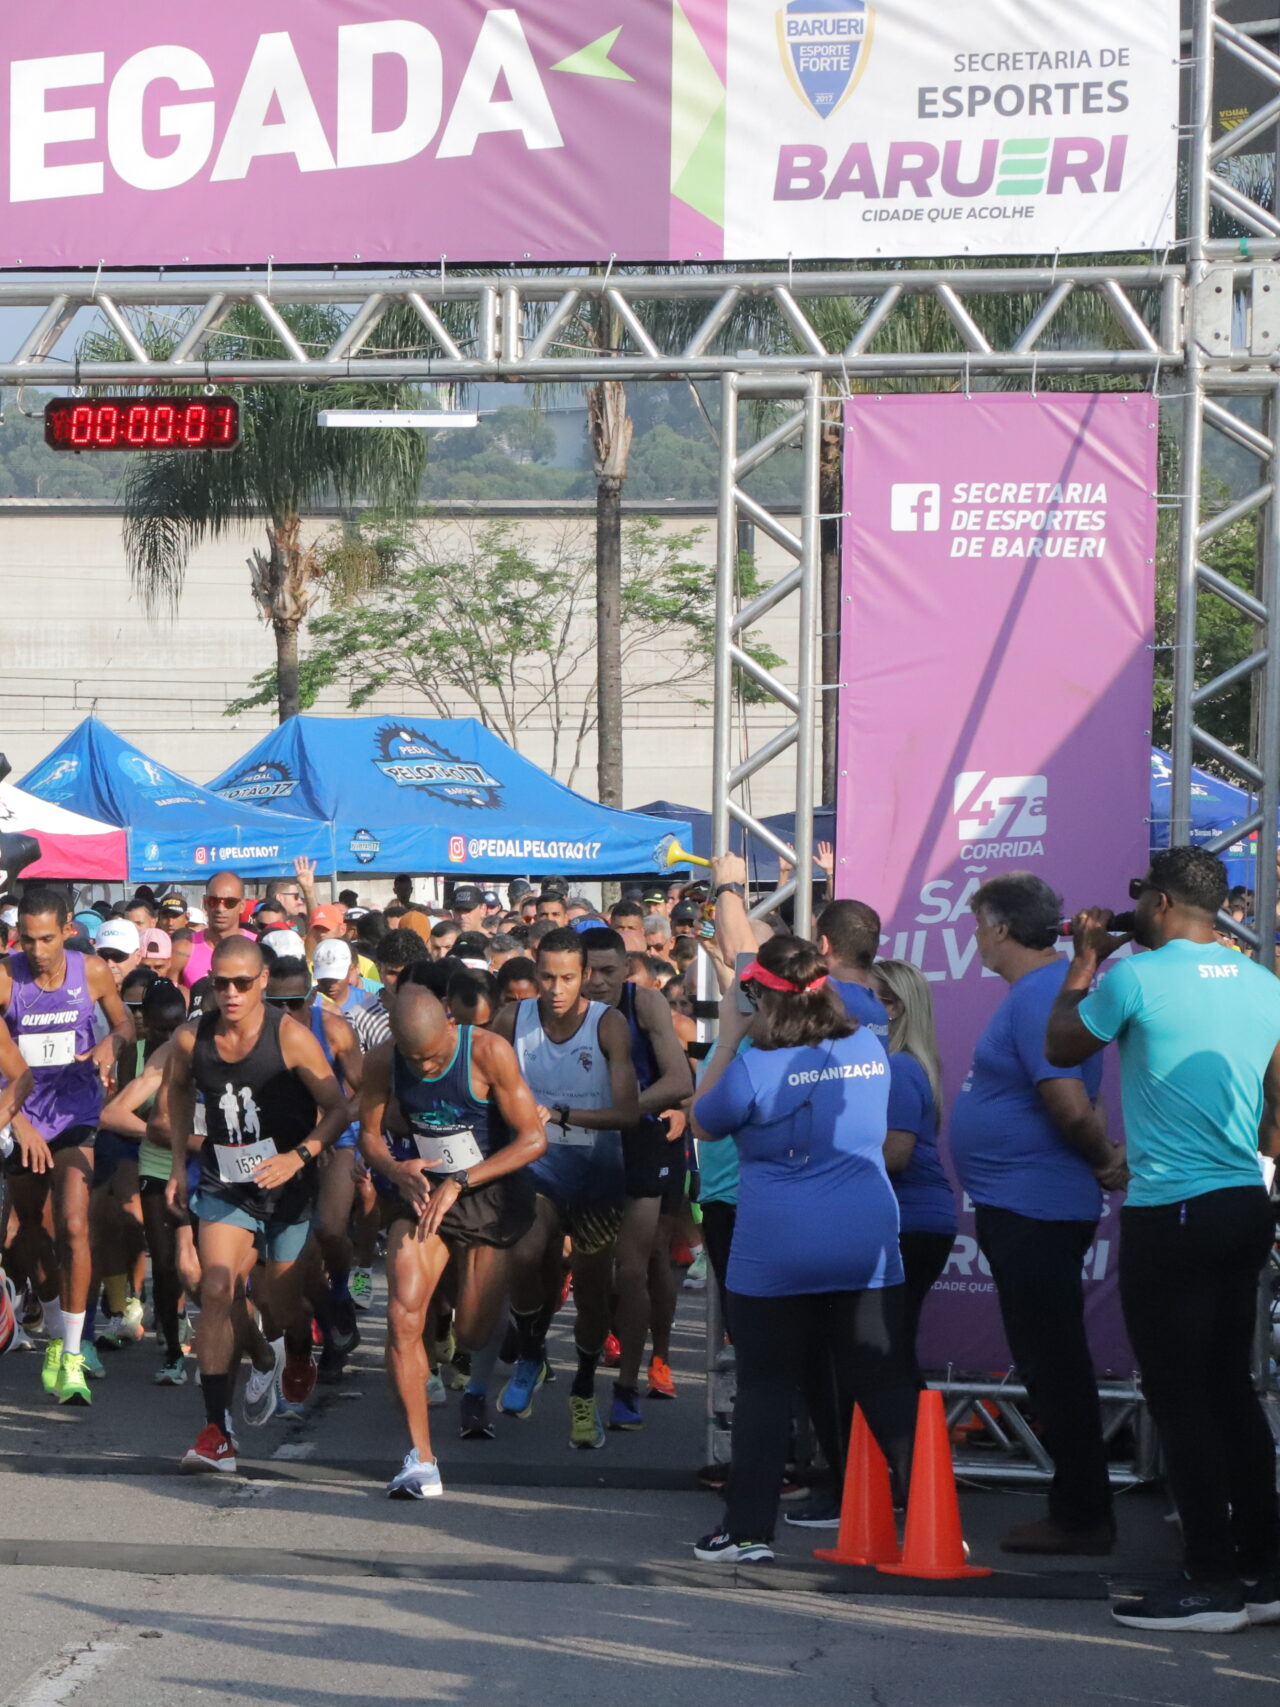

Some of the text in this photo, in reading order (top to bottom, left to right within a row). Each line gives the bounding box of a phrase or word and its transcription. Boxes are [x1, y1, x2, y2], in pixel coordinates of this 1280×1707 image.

[787, 19, 864, 36] BARUERI
[800, 45, 850, 56] ESPORTE
[954, 48, 1130, 73] SECRETARIA DE
[800, 57, 850, 72] FORTE
[918, 80, 1129, 119] ESPORTES
[773, 135, 1129, 200] BARUERI
[862, 206, 1034, 223] CIDADE QUE ACOLHE
[72, 406, 231, 442] 00:00:01
[952, 483, 1107, 504] SECRETARIA
[950, 510, 1106, 531] DE ESPORTES
[949, 537, 1105, 558] DE BARUERI
[469, 839, 602, 859] @PEDALPELOTAO17
[960, 840, 1044, 860] CORRIDA
[914, 865, 988, 924] SÃ
[1198, 964, 1239, 978] STAFF
[21, 1010, 79, 1026] OLYMPIKUS
[43, 1043, 55, 1058] 17
[788, 1061, 885, 1086] ORGANIZAÇÃO
[443, 1149, 454, 1164] 3
[968, 1282, 994, 1293] QUE
